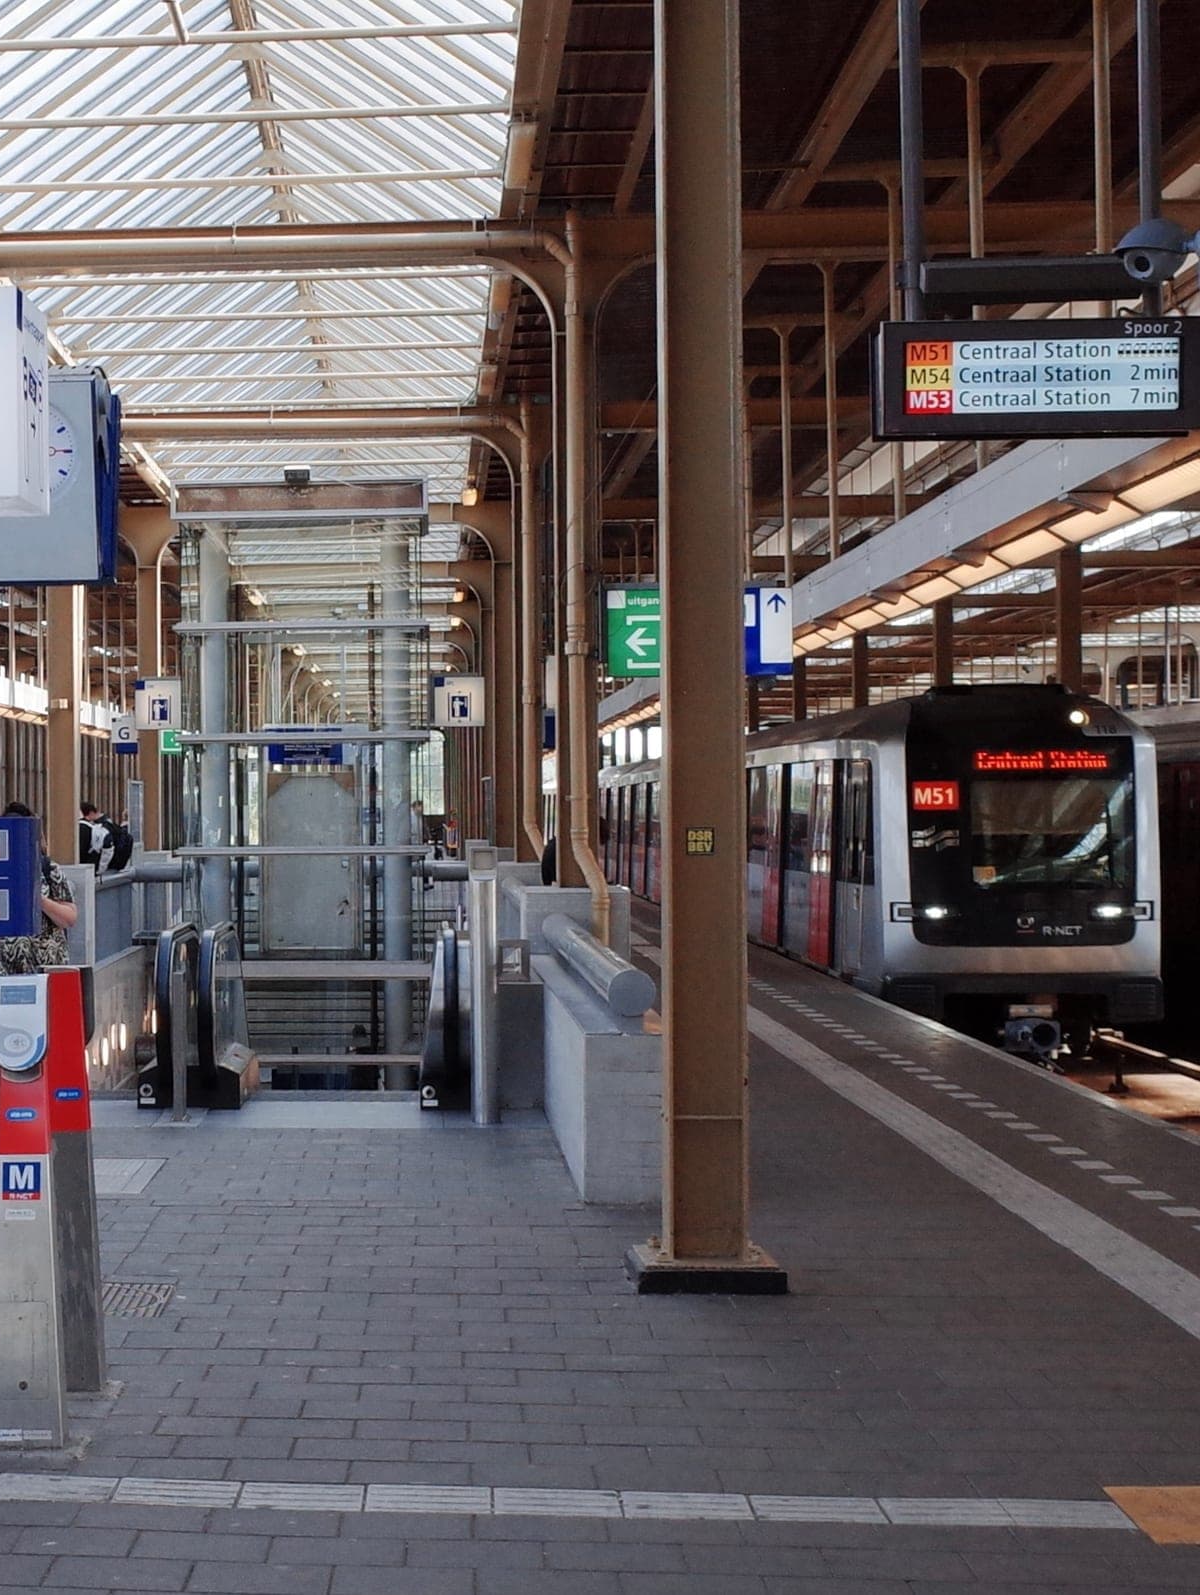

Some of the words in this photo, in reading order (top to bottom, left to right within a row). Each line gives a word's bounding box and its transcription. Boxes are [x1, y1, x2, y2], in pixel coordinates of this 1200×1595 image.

[1125, 322, 1168, 336] Spoor
[1174, 321, 1182, 333] 2
[910, 345, 948, 361] M51
[960, 343, 1036, 359] Centraal
[1045, 343, 1110, 358] Station
[911, 369, 949, 384] M54
[960, 365, 1036, 383] Centraal
[1045, 365, 1110, 382] Station
[1131, 365, 1140, 380] 2
[1145, 365, 1178, 379] min
[910, 392, 950, 409] M53
[960, 389, 1036, 407] Centraal
[1045, 389, 1110, 405] Station
[1131, 389, 1139, 403] 7
[1145, 389, 1178, 403] min
[119, 727, 129, 740] G
[914, 789, 952, 804] M51
[688, 831, 712, 840] DSR
[688, 842, 712, 851] BEV
[8, 1165, 34, 1189] M
